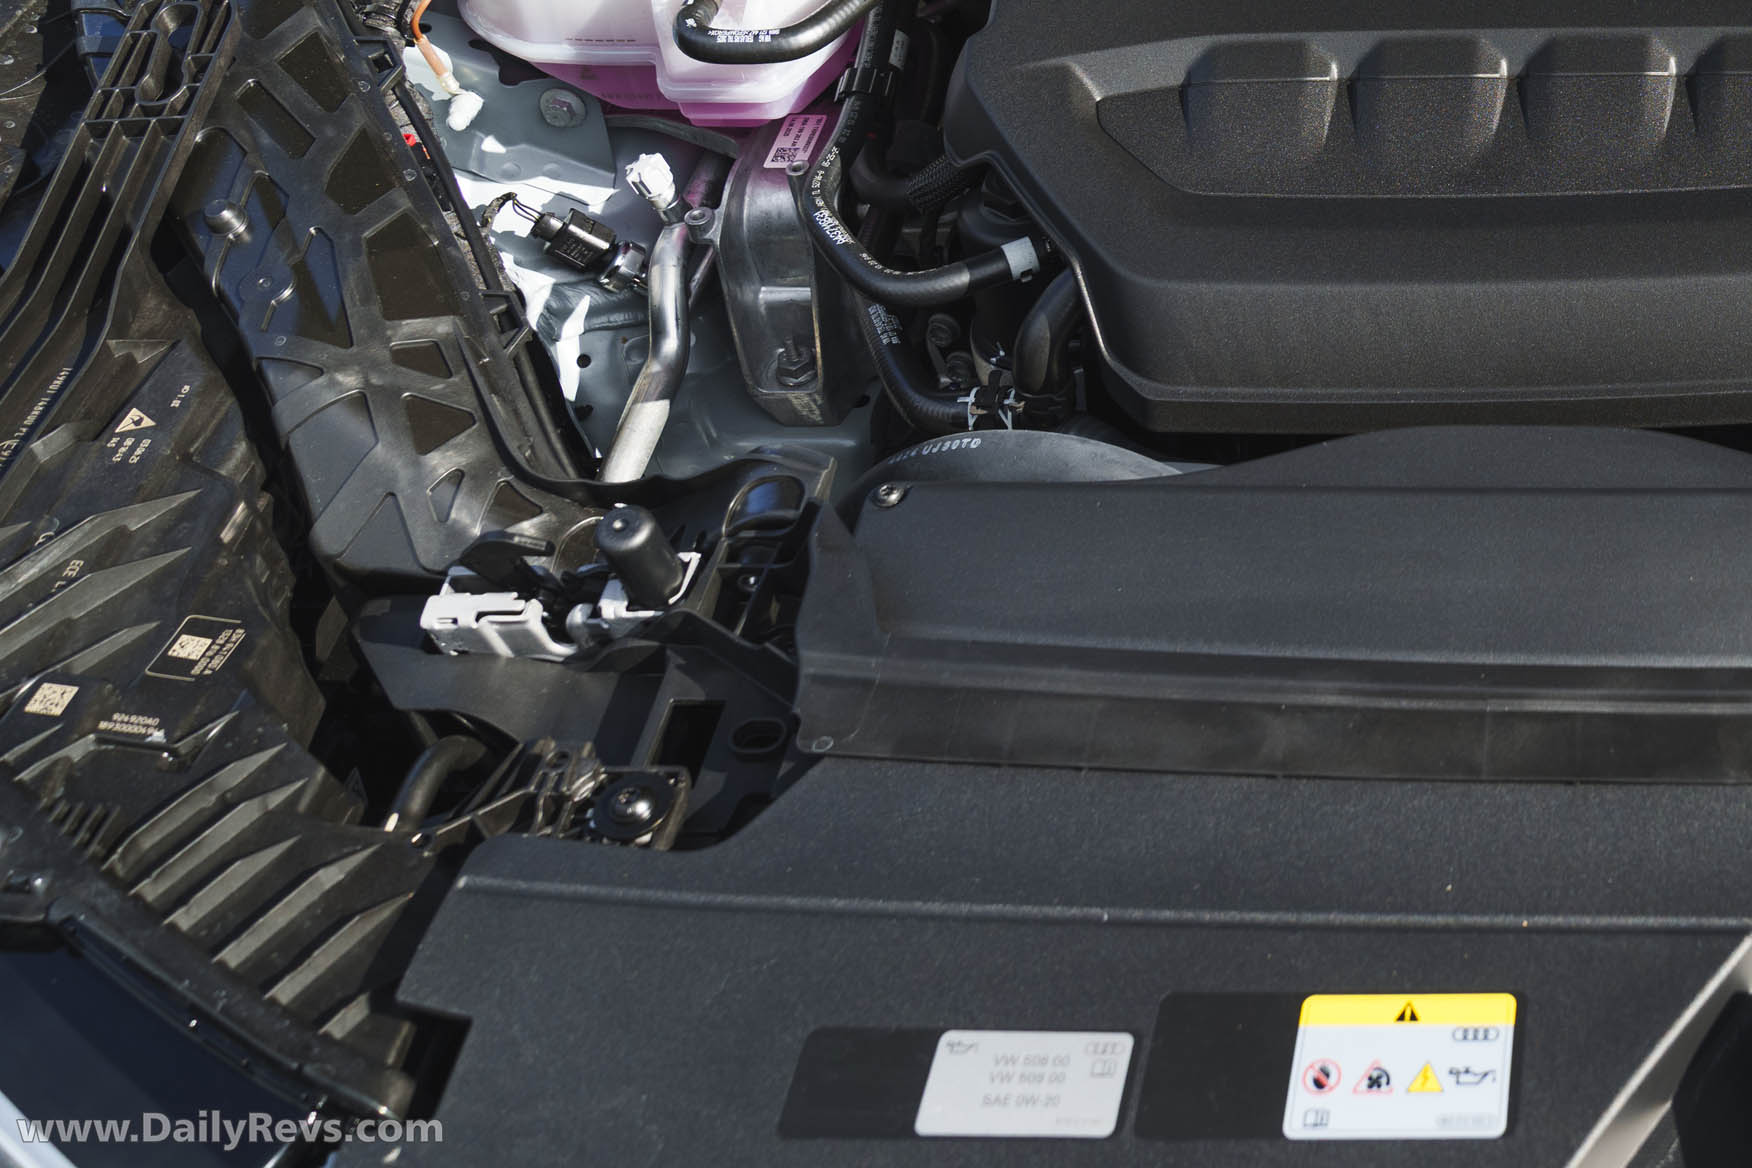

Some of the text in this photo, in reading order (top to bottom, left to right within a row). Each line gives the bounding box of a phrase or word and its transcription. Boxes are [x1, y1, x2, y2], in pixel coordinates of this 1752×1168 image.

[994, 1054, 1020, 1067] VW
[990, 1071, 1014, 1083] VW
[982, 1094, 1010, 1107] SAE
